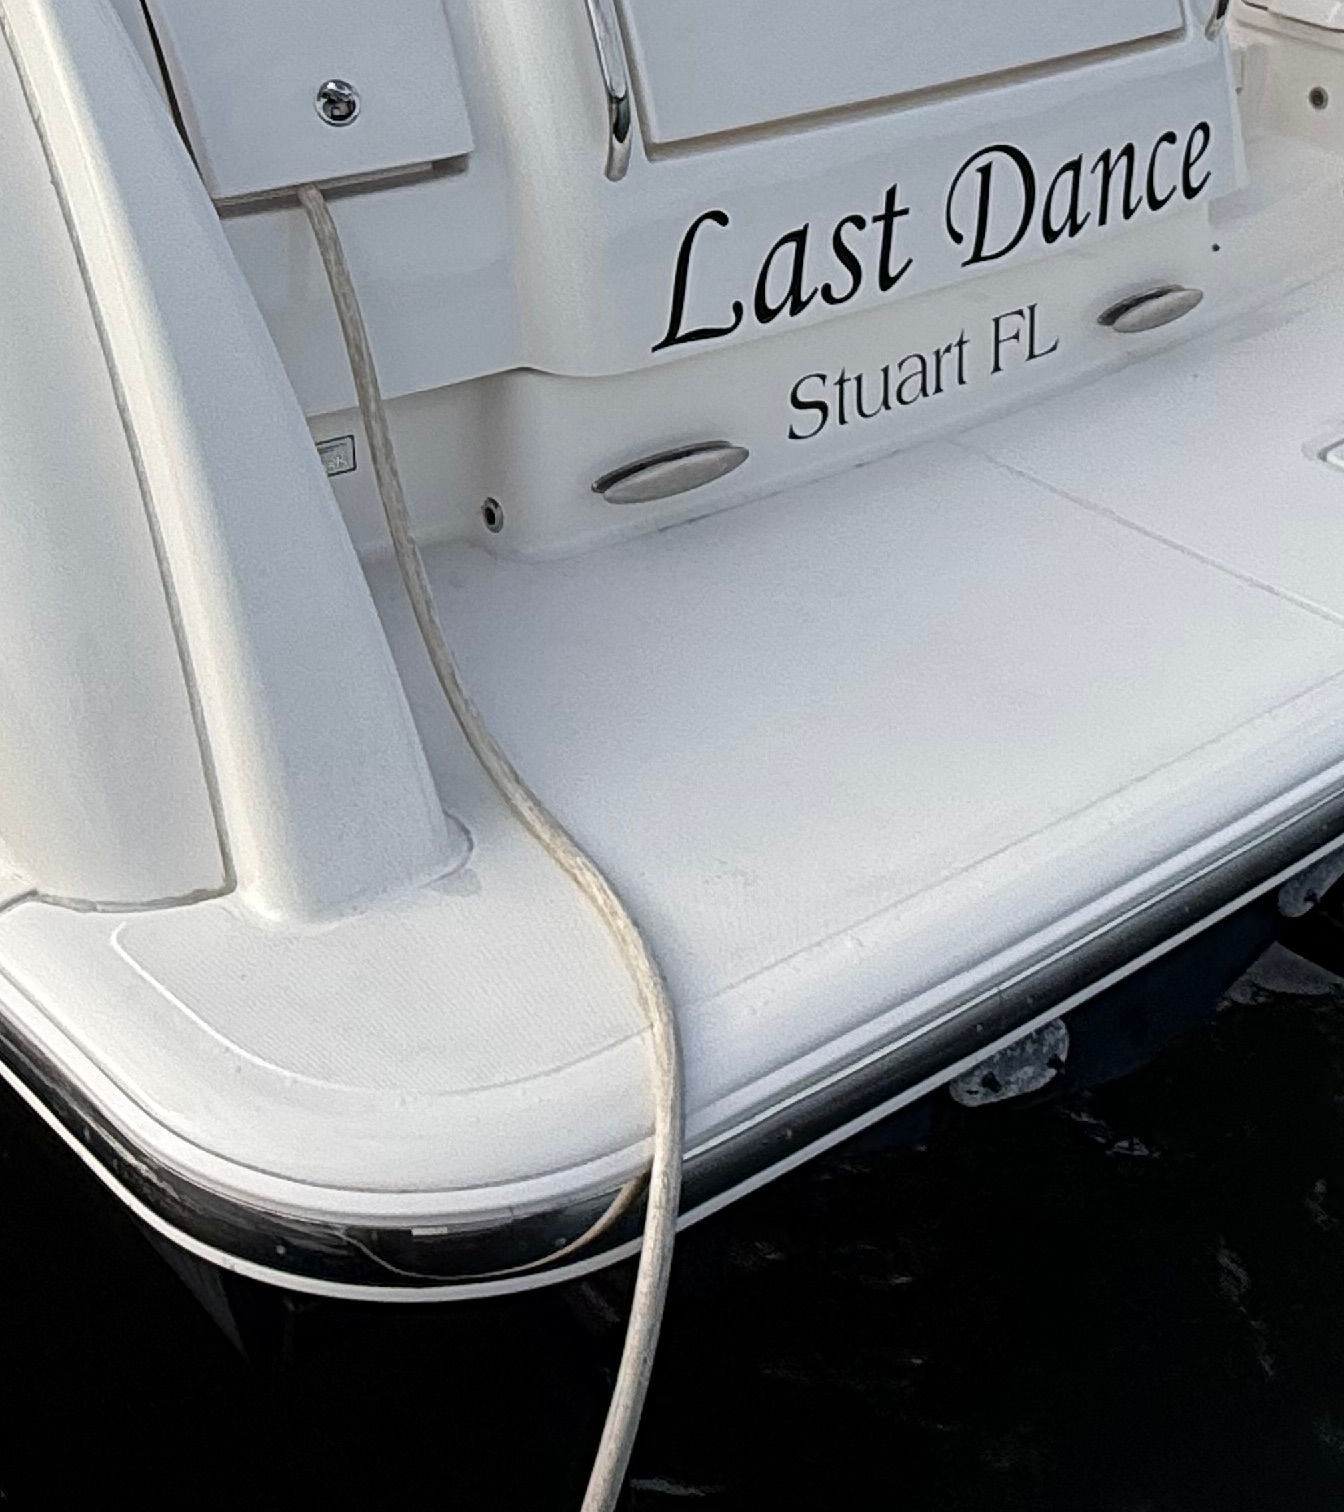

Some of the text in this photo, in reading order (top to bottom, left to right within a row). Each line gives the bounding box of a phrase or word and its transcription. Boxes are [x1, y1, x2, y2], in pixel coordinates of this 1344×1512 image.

[650, 120, 1213, 354] Last Dance
[787, 303, 1059, 441] Stuart FL
